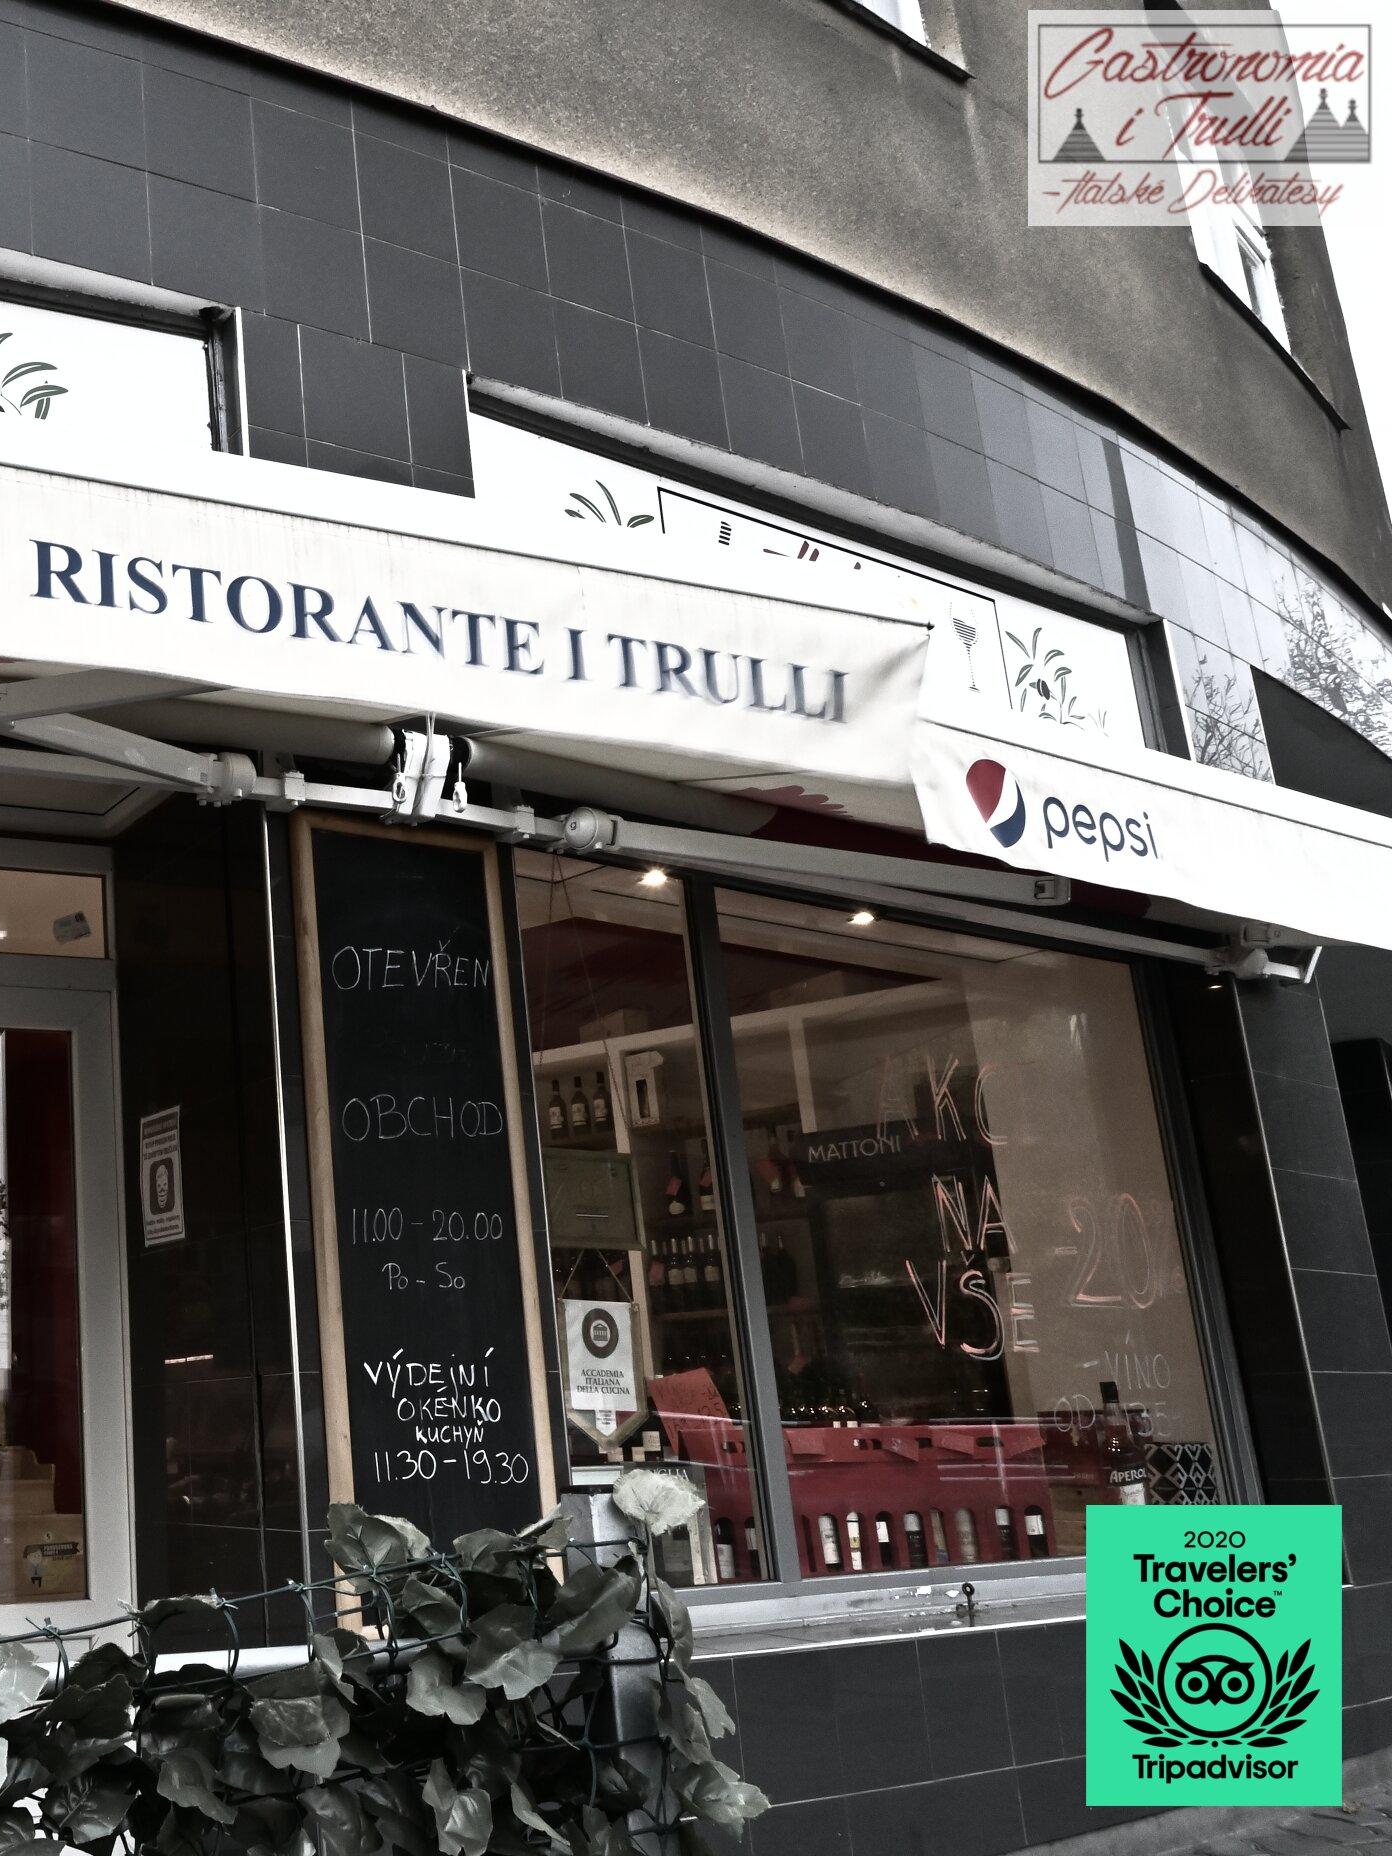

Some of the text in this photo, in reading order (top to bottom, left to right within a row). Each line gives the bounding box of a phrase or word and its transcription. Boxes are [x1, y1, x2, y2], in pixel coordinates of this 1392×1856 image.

[28, 538, 850, 724] RISTORANTE I TRULLI
[1042, 796, 1158, 861] pepsi
[331, 939, 490, 990] OTEVŘEN
[342, 1093, 503, 1142] OBCHOD
[808, 1135, 902, 1163] MATTONI
[931, 1173, 1017, 1253] NA
[905, 1251, 1040, 1361] VŠE
[576, 1385, 630, 1395] DELLA CUCINA
[580, 1369, 624, 1378] ACCADEMIA
[585, 1377, 620, 1386] ITALIANA
[415, 1420, 484, 1449] KUCHYŇ
[374, 1450, 437, 1483] 11.30
[464, 1450, 529, 1484] 19.30
